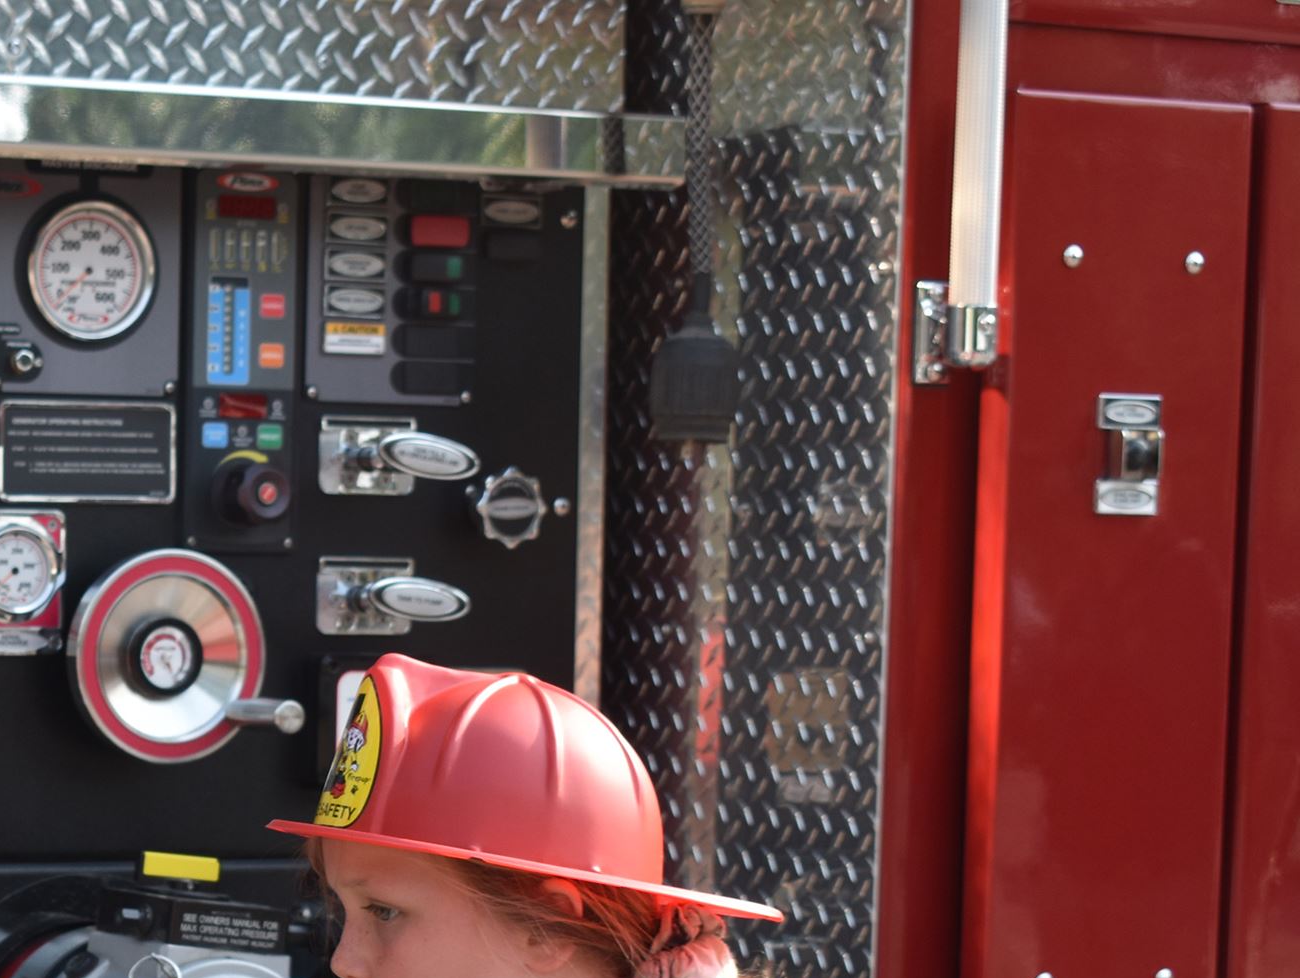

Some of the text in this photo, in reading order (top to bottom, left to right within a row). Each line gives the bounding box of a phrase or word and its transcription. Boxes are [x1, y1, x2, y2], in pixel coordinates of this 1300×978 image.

[81, 230, 100, 241] 300
[61, 240, 80, 252] 200
[100, 246, 120, 257] 400
[51, 262, 70, 273] 100
[106, 269, 125, 280] 500
[95, 292, 115, 304] 600
